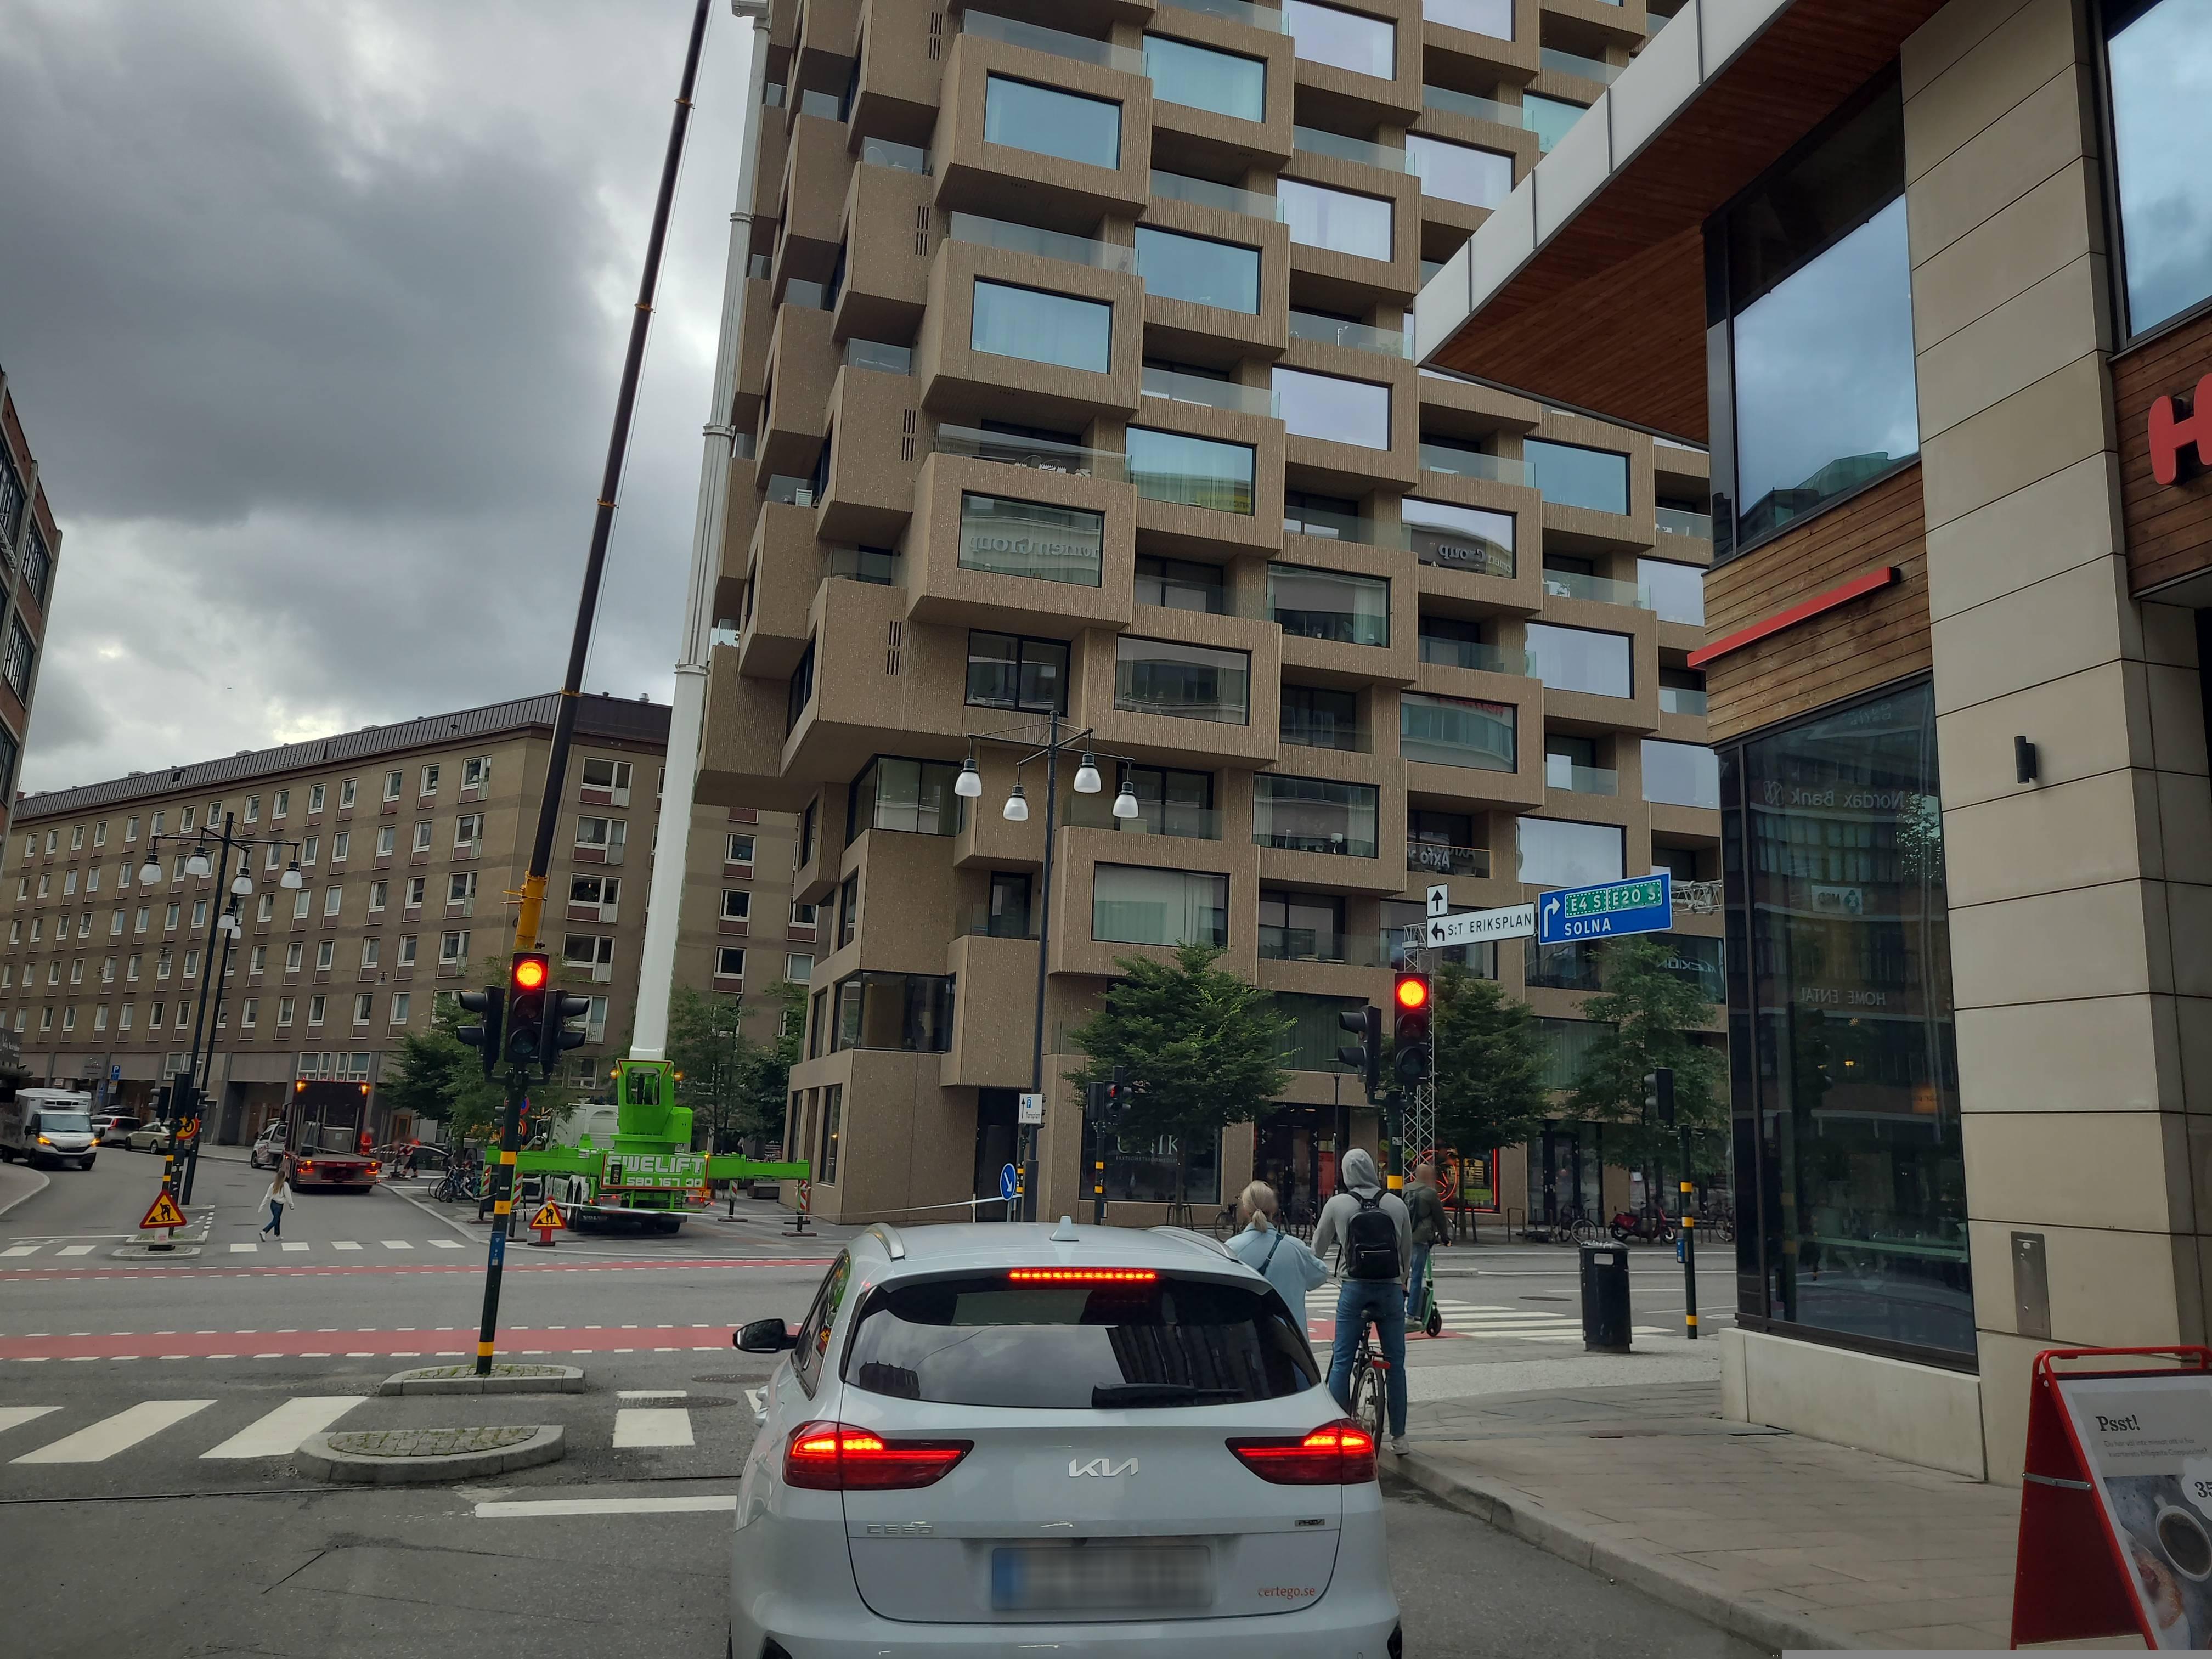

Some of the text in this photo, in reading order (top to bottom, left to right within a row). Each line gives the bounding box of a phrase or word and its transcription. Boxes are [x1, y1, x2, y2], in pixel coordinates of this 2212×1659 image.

[1571, 887, 1656, 911] E4 S E20 S
[1448, 913, 1531, 935] S:T ERIKSPLAN
[1565, 917, 1611, 936] SOLNA
[1116, 1134, 1178, 1155] UIK
[607, 1155, 706, 1173] SWELIFT
[627, 1176, 653, 1186] 580
[659, 1177, 680, 1187] 167
[2095, 1414, 2141, 1431] Psst!
[1068, 1458, 1139, 1477] KIA
[1257, 1586, 1315, 1600] certego.se
